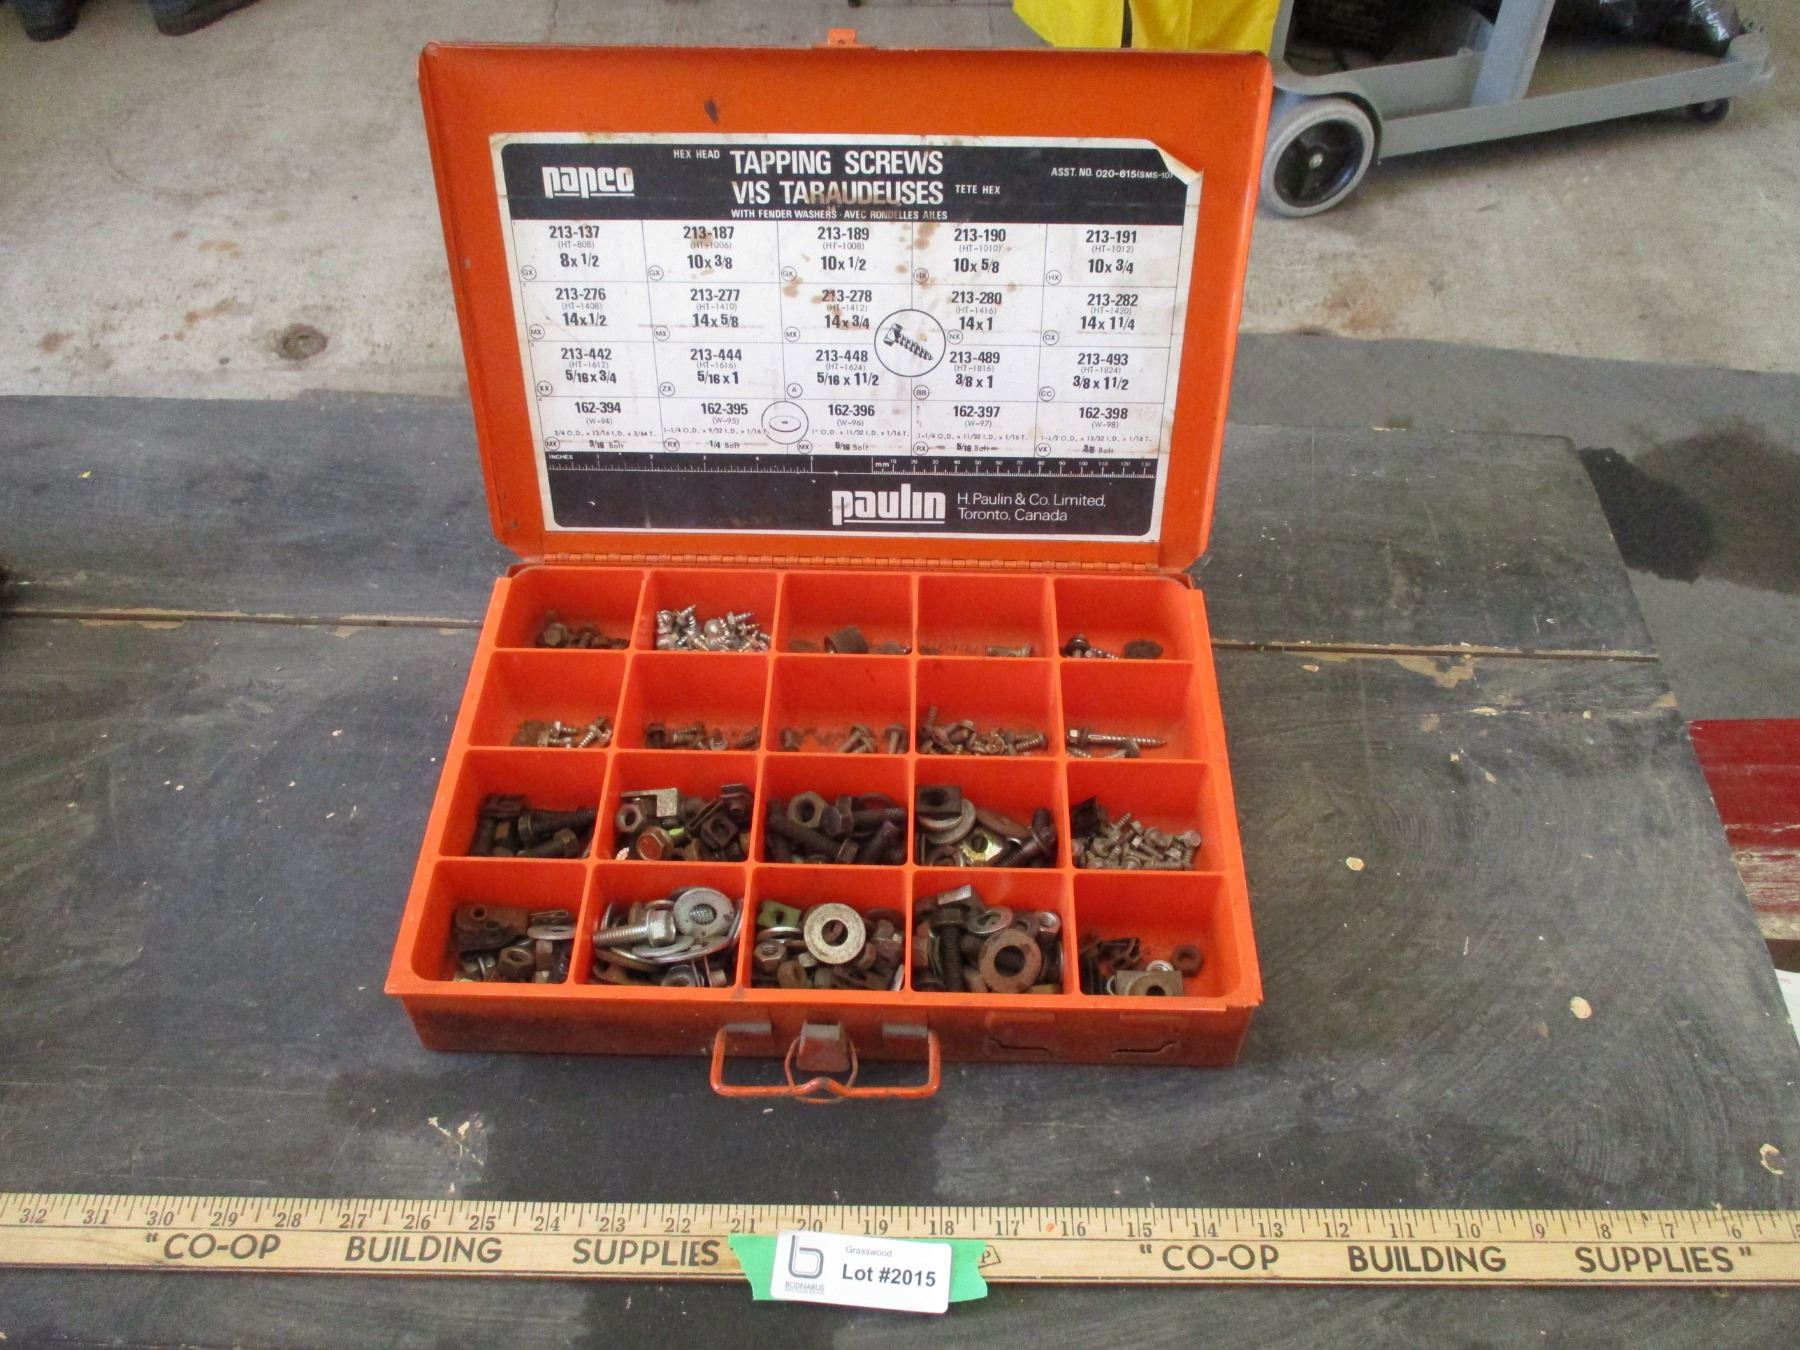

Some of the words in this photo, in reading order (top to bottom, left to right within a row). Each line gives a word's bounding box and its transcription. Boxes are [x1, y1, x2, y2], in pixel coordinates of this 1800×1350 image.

[673, 150, 691, 159] HEX
[696, 150, 720, 159] HEAD
[730, 150, 831, 175] TAPPING
[844, 150, 944, 175] SCREWS
[1050, 167, 1077, 177] ASST.
[1079, 168, 1093, 178] NO.
[541, 166, 635, 199] papco
[731, 180, 770, 205] VIS
[779, 181, 944, 205] TARAUDEUSES
[955, 184, 978, 194] TETE
[982, 185, 1001, 195] HEX
[731, 209, 755, 218] WITH
[758, 209, 792, 219] FENDER
[794, 209, 837, 219] WASHERS
[843, 210, 867, 219] AVEC
[870, 210, 919, 220] RONDELLES
[922, 210, 947, 220] AILES
[549, 225, 600, 239] 213-137
[683, 226, 735, 240] 213-187
[818, 226, 870, 241] 213-189
[953, 228, 1007, 242] 213-190
[1085, 229, 1137, 244] 213-191
[555, 287, 607, 301] 213-276
[690, 288, 740, 301] 213-277
[822, 289, 872, 302] 213-278
[951, 291, 1002, 304] 213-280
[1087, 293, 1139, 307] 213-282
[561, 348, 612, 360] 213-442
[690, 349, 742, 361] 213-444
[816, 350, 868, 362] 213-448
[950, 351, 1000, 364] 213-489
[1077, 353, 1129, 366] 213-493
[574, 401, 622, 414] 162-394
[701, 402, 749, 415] 162-395
[828, 404, 875, 417] 162-396
[953, 405, 1001, 418] 162-397
[1079, 407, 1128, 420] 162-398
[832, 483, 946, 525] paulin
[957, 493, 970, 505] H.
[973, 492, 1012, 505] Paulin
[1014, 494, 1026, 505] &
[1027, 494, 1050, 506] Co.
[1053, 494, 1106, 508] Limited,
[1014, 508, 1068, 521] Canada
[1535, 1223, 1546, 1239] 9
[1600, 1224, 1612, 1239] 8
[1665, 1223, 1675, 1239] 7
[1731, 1225, 1742, 1239] 6
[344, 1236, 503, 1263] BUILDING
[572, 1238, 720, 1266] SUPPLIES
[845, 1245, 893, 1258] Grasswood
[1347, 1246, 1507, 1273] BUILDING
[842, 1263, 873, 1282] Lot
[879, 1267, 936, 1287] #2015
